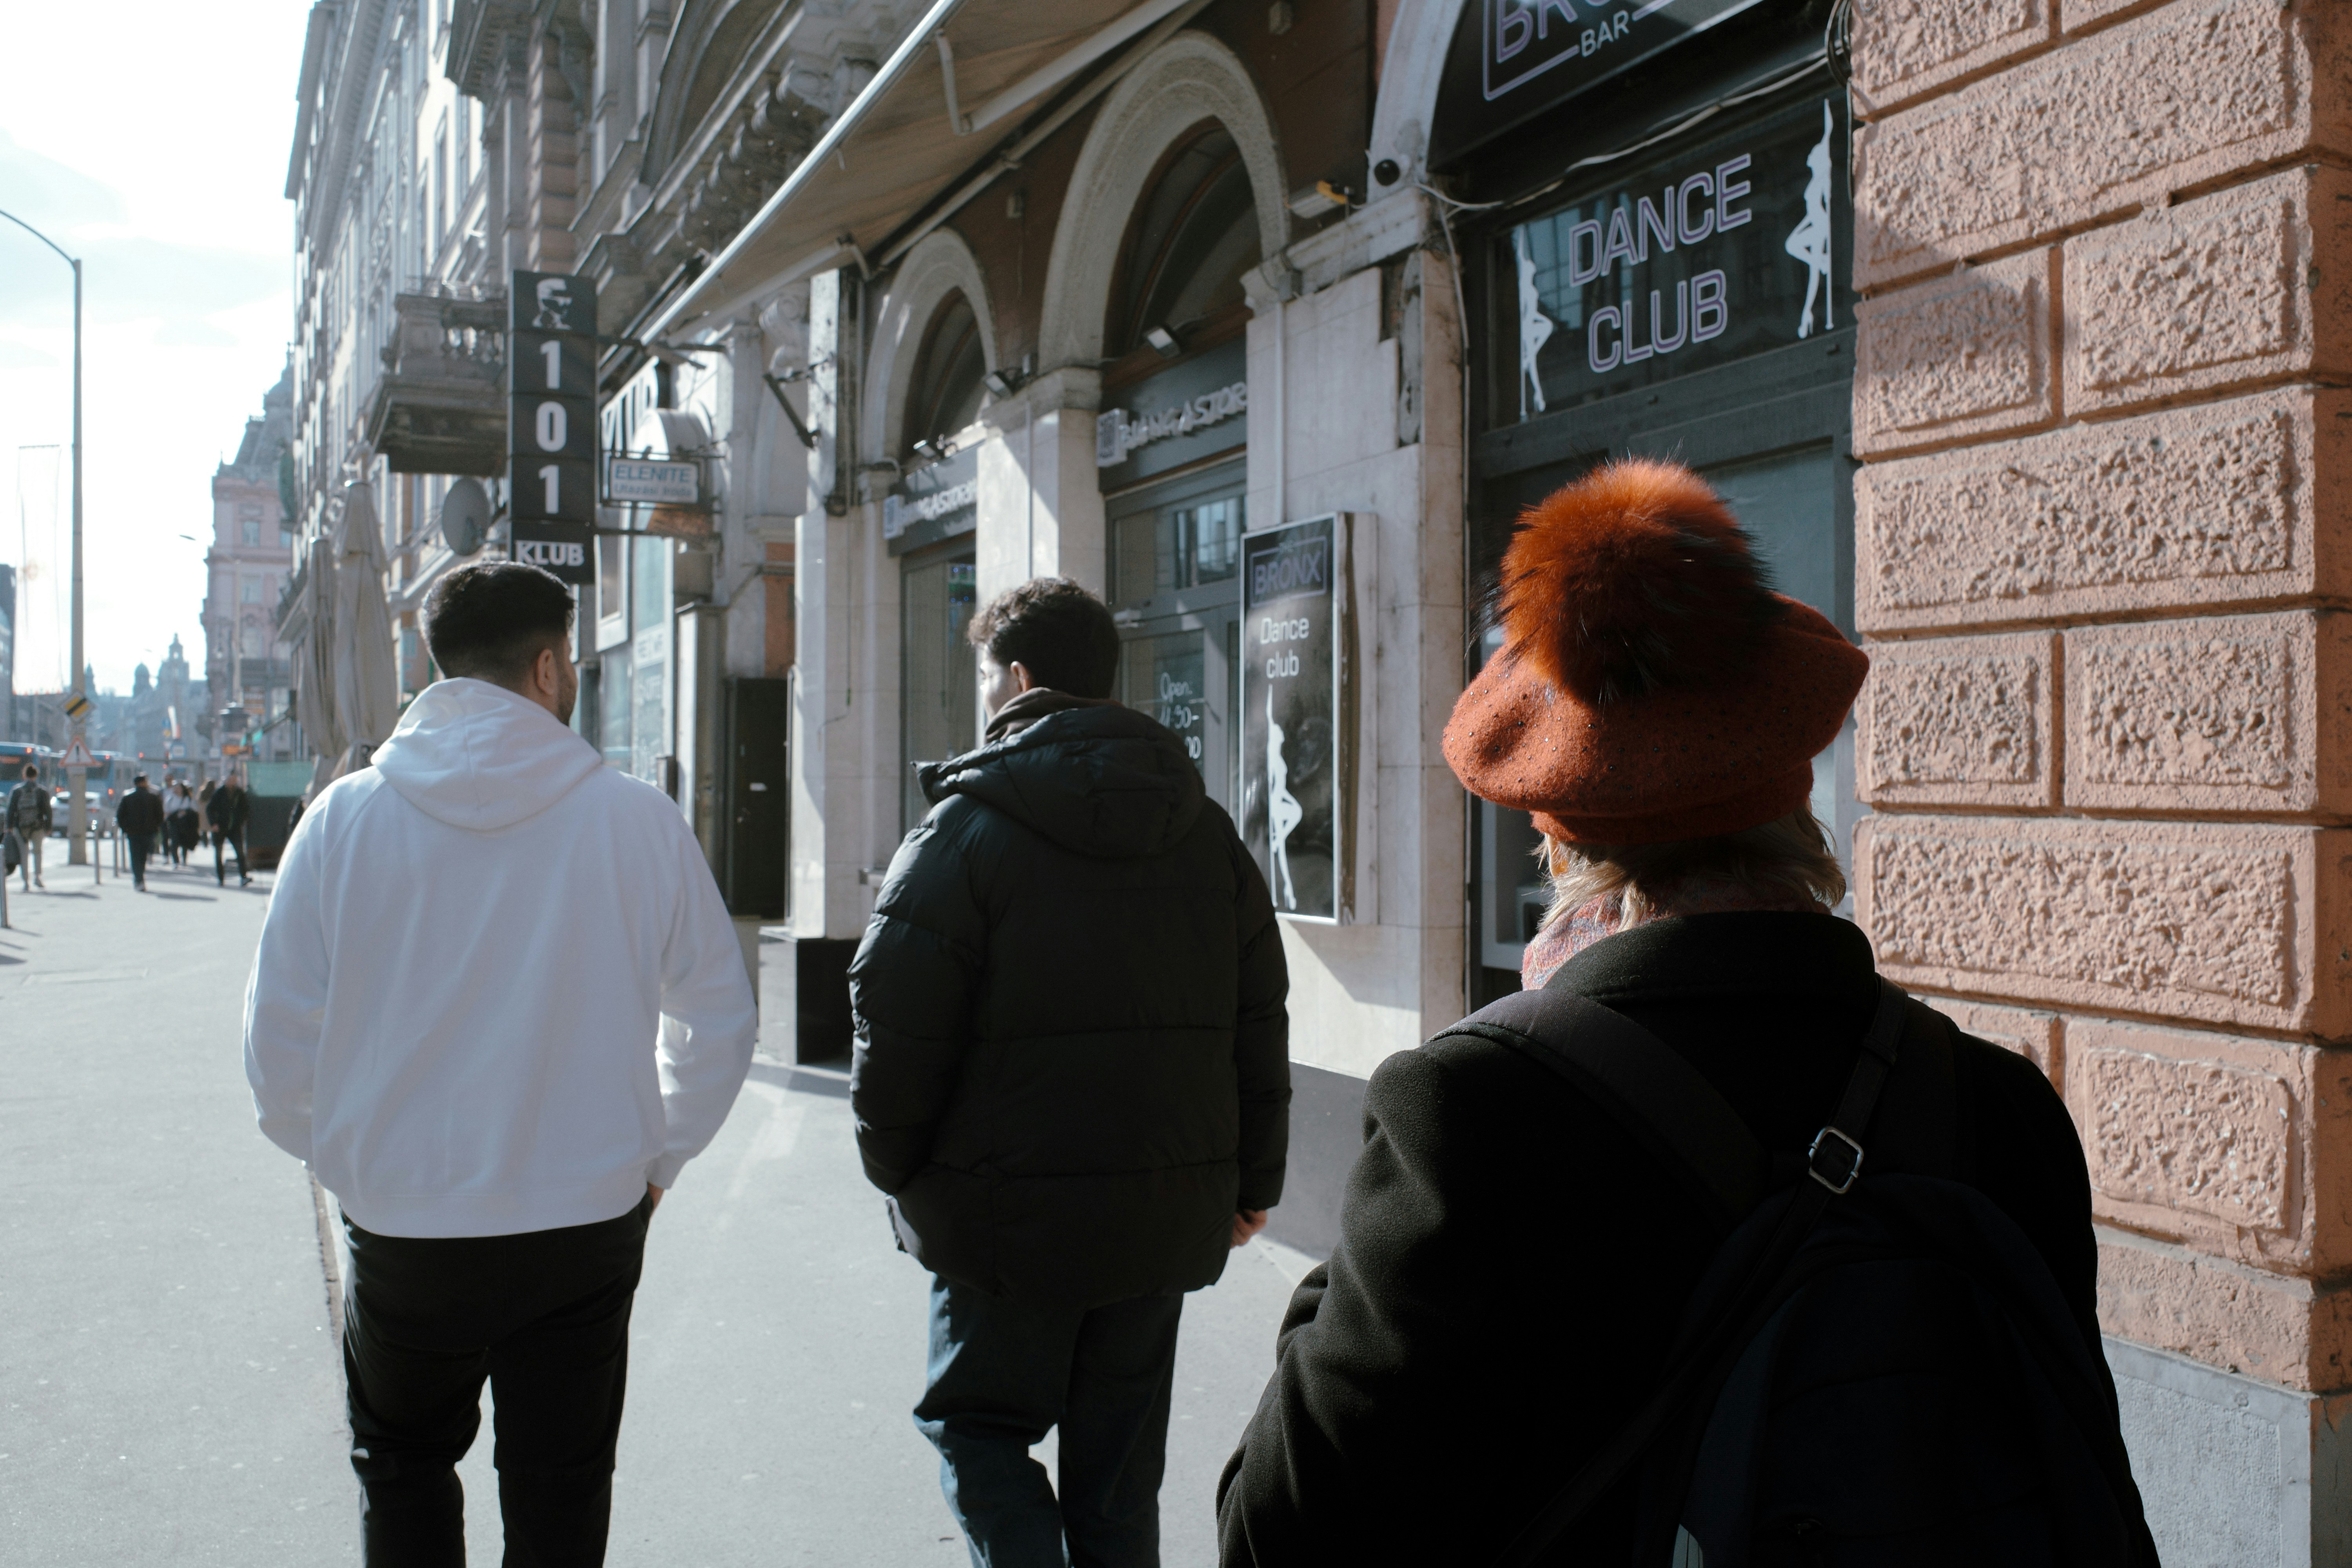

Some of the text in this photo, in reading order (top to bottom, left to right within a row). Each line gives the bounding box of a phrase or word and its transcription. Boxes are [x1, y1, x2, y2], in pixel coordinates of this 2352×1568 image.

[1581, 10, 1629, 57] BAR
[1570, 153, 1751, 287] DANCE
[1588, 269, 1728, 373] CLUB
[616, 464, 691, 483] ELENITE
[515, 540, 584, 566] KLUB
[1255, 550, 1321, 595] BRONX
[1260, 617, 1310, 645] Dance
[1266, 649, 1299, 679] club
